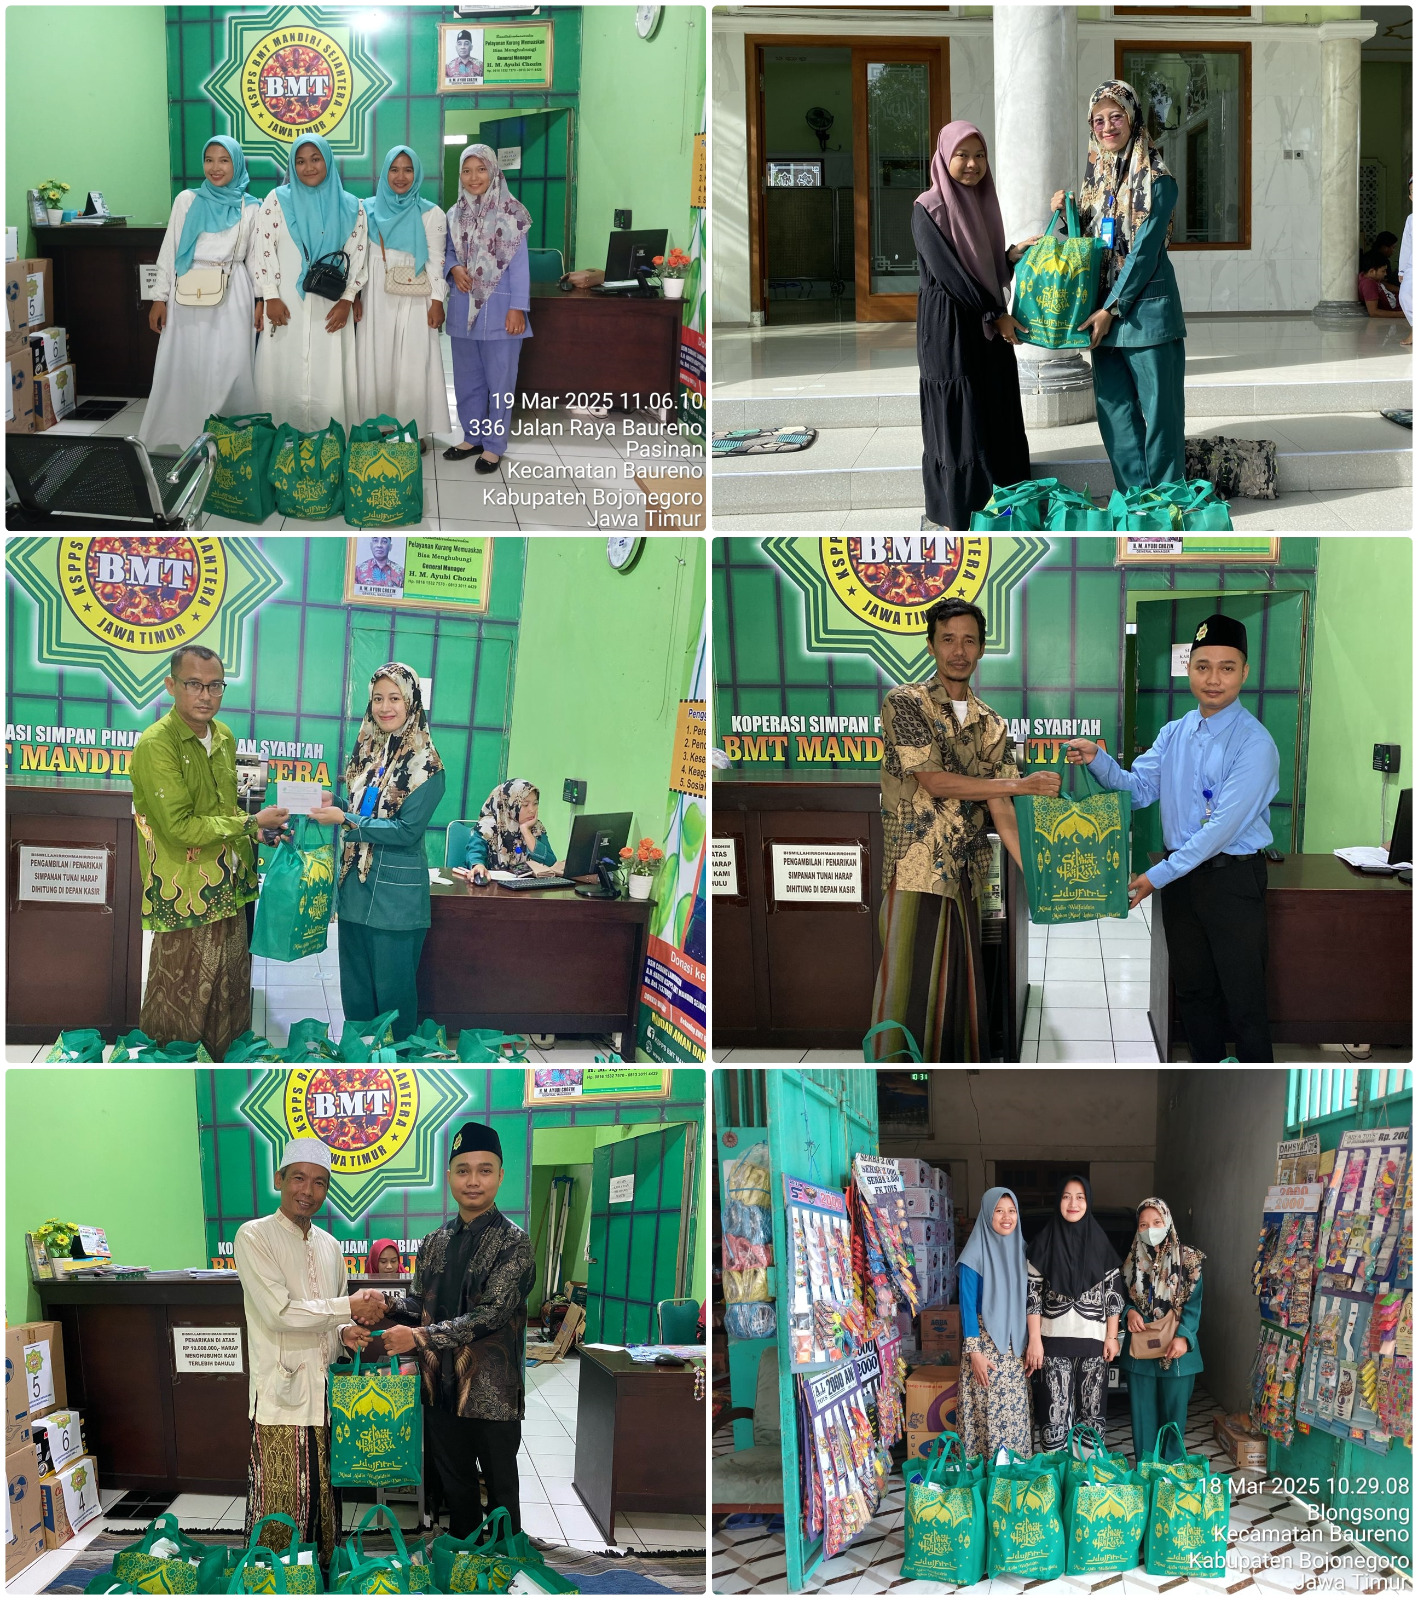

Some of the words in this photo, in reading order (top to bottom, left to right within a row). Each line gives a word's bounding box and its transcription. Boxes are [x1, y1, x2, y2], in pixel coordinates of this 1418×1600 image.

[273, 33, 322, 47] MANDIRI
[252, 45, 270, 67] BMT
[323, 44, 346, 107] SEJAHTERA
[248, 71, 260, 108] KSPPS
[264, 75, 329, 97] BMT
[268, 121, 293, 137] JAWA
[296, 120, 326, 137] TIMUR
[29, 299, 36, 316] 5
[53, 341, 59, 358] 6
[60, 390, 67, 406] 4
[409, 541, 433, 550] Pelayanan
[435, 544, 452, 552] Kurang
[453, 545, 482, 554] Memuaskan
[858, 537, 955, 564] BMT
[68, 540, 86, 596] KSPPS
[432, 554, 472, 563] Menghubungi
[96, 552, 193, 589] BMT
[430, 572, 450, 581] Ayubi
[443, 564, 465, 573] Manager
[862, 600, 900, 625] JAWA
[905, 612, 929, 625] TIM
[97, 618, 135, 643] JAWA
[140, 623, 186, 644] TIMUR
[686, 725, 691, 734] 1.
[732, 715, 805, 733] KOPERASI
[809, 716, 868, 733] SIMPAN
[1034, 719, 1100, 735] SYARI'AH
[36, 725, 98, 745] SIMPAN
[684, 738, 690, 748] 2.
[260, 739, 324, 759] SYARI'AH
[683, 752, 688, 760] 3.
[722, 736, 788, 761] BMT
[681, 765, 686, 774] 4.
[680, 778, 685, 786] 5.
[31, 860, 68, 868] PENGAMBILAN
[786, 885, 812, 893] DIHITUNG
[670, 951, 693, 976] Donasi
[695, 970, 706, 981] ke
[672, 1029, 691, 1052] AMAN
[292, 1087, 306, 1133] KSPPS
[312, 1090, 390, 1118] BMT
[1378, 1133, 1390, 1141] Rp.
[350, 1145, 387, 1166] TIMUR
[820, 1192, 842, 1210] 2000
[1275, 1197, 1304, 1209] 2000
[32, 1375, 41, 1398] 5
[826, 1372, 844, 1395] 2000
[62, 1429, 70, 1452] 6
[78, 1492, 86, 1512] 4
